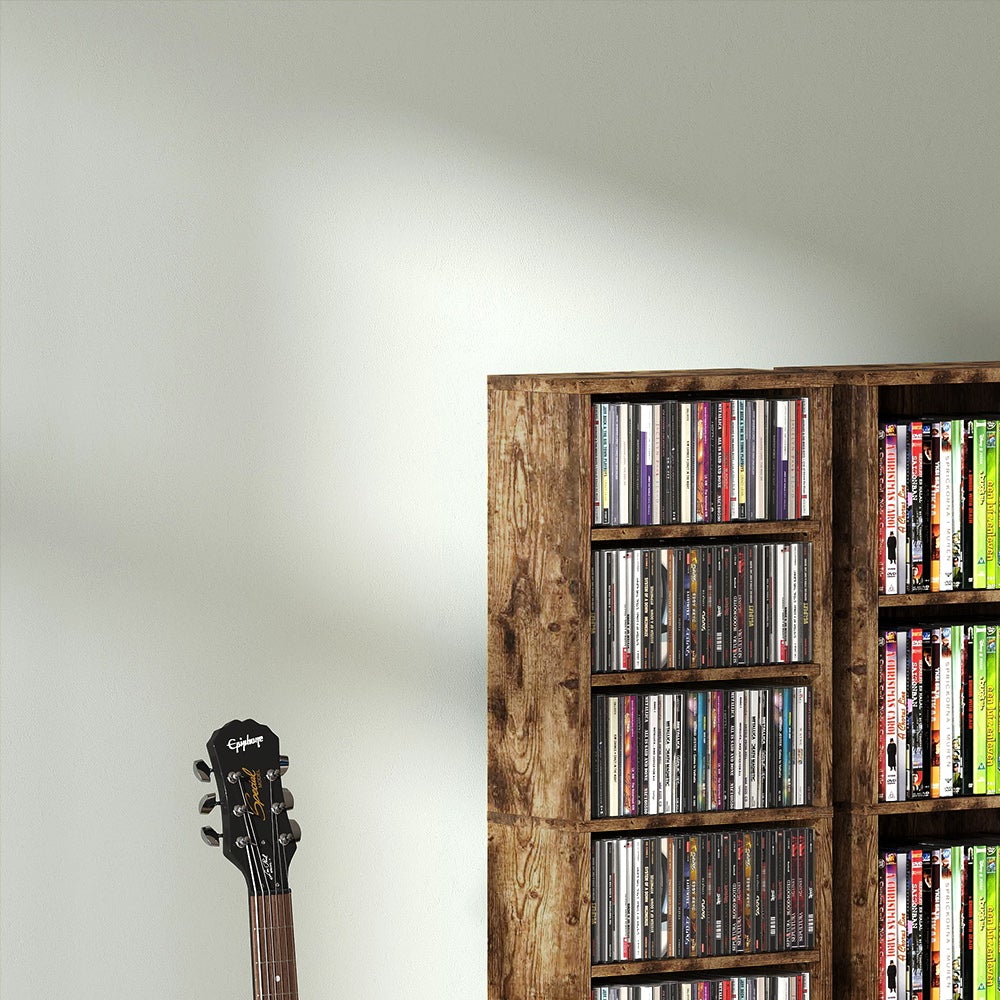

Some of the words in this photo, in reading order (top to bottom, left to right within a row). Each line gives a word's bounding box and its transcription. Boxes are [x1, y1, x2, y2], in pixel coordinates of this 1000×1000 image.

[886, 452, 896, 501] CHRISTMAS
[226, 734, 264, 753] Epiphone
[242, 767, 266, 821] Special
